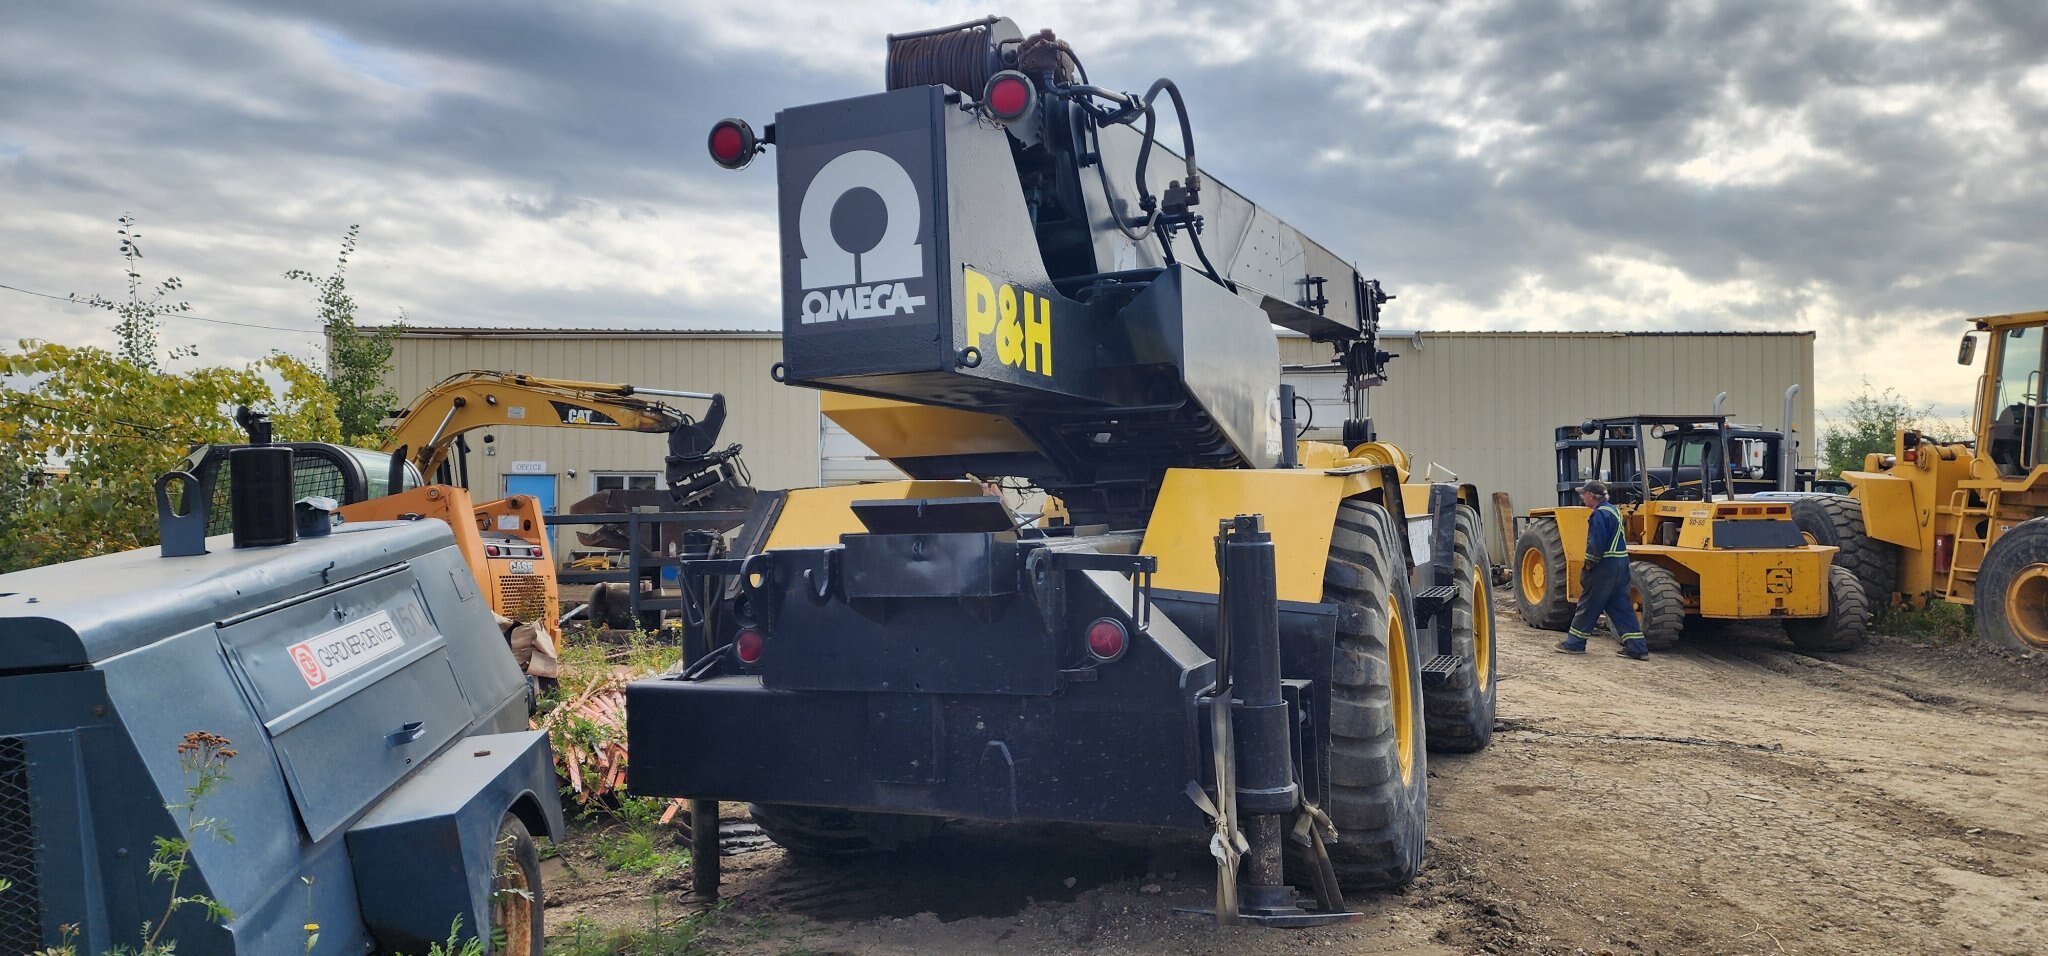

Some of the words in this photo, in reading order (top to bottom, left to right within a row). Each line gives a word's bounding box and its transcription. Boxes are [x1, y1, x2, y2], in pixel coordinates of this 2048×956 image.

[964, 267, 1052, 377] P&H
[567, 408, 592, 424] CAT
[516, 463, 542, 471] OFFICE
[509, 560, 533, 574] CASE
[317, 621, 397, 668] GARDNER-DENVER
